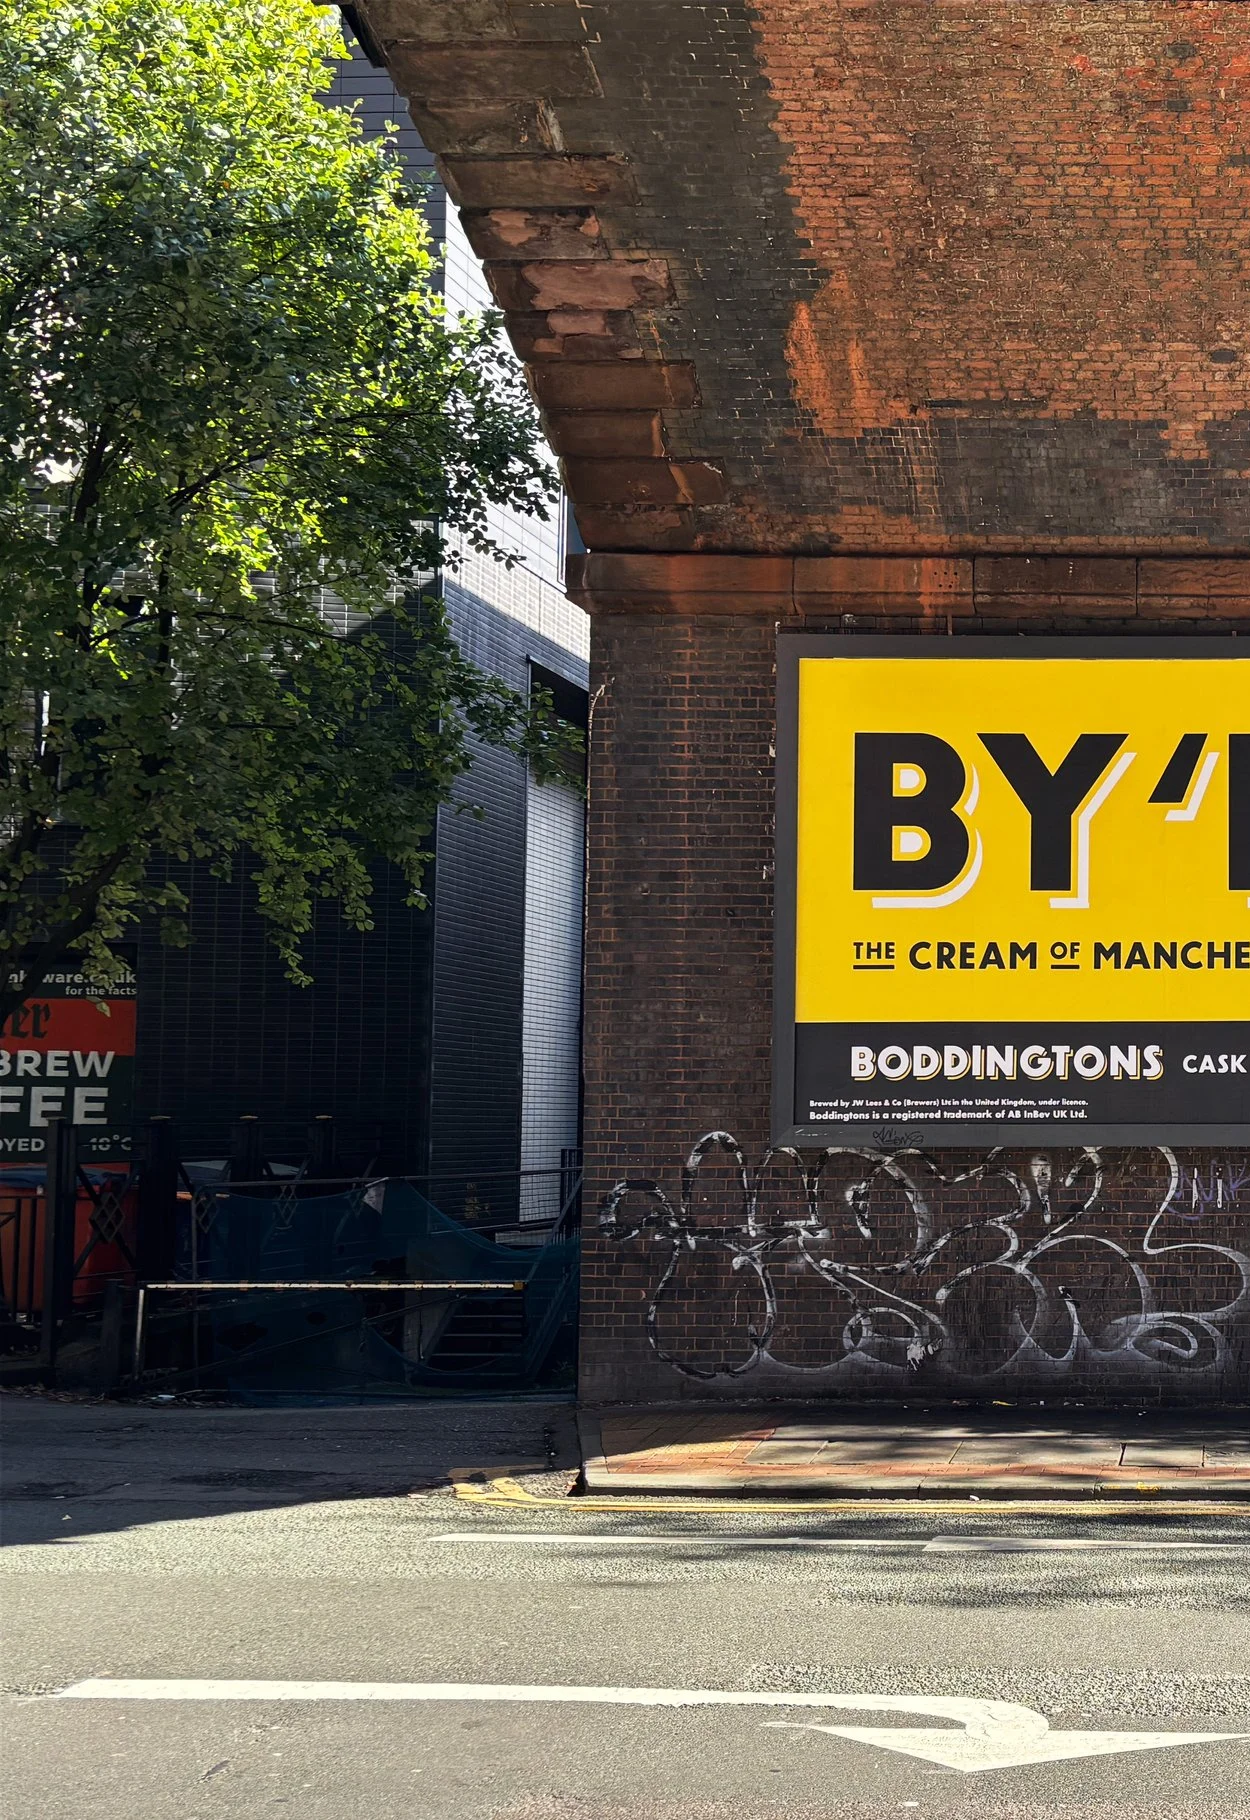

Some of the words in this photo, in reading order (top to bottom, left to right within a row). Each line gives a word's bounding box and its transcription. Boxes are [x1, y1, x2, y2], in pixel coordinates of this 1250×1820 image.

[853, 942, 896, 961] THE
[908, 941, 1038, 970] CREAM
[1050, 941, 1081, 961] OF
[65, 986, 82, 996] for
[85, 986, 106, 996] the
[850, 1045, 1164, 1082] BODDINGTONS
[1182, 1054, 1248, 1074] CASK
[840, 1100, 850, 1109] by
[892, 1099, 902, 1107] Co
[904, 1099, 939, 1108] (Brewers)
[961, 1099, 974, 1107] the
[975, 1099, 1000, 1107] United
[1001, 1099, 1037, 1108] Kingdom,
[1038, 1099, 1060, 1107] under
[1062, 1098, 1089, 1107] licence.
[809, 1111, 870, 1121] Boddingtons
[872, 1111, 881, 1120] is
[882, 1112, 890, 1120] a
[891, 1110, 942, 1121] registered
[943, 1110, 993, 1119] trademark
[995, 1110, 1006, 1119] of
[1007, 1110, 1021, 1119] AB
[1023, 1110, 1051, 1119] InBev
[1053, 1110, 1068, 1119] UK
[1070, 1110, 1088, 1119] Ltd.
[0, 1138, 46, 1152] YED
